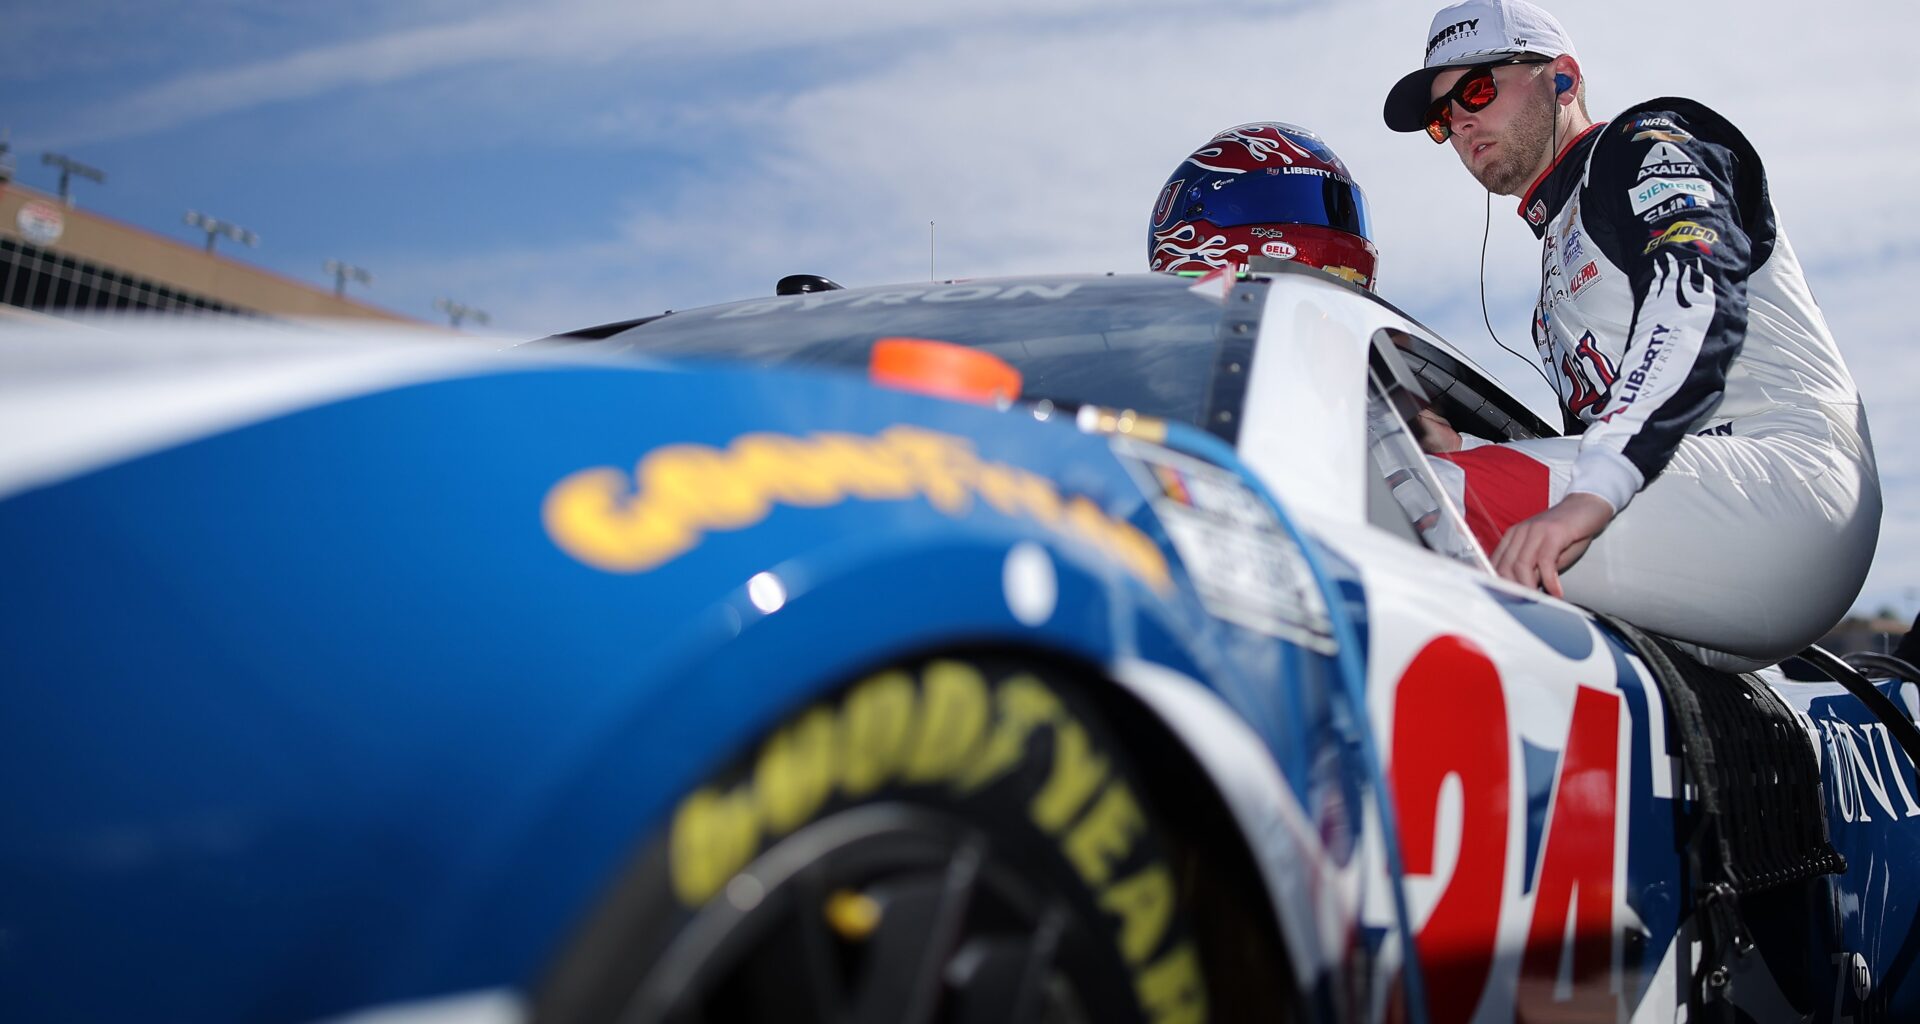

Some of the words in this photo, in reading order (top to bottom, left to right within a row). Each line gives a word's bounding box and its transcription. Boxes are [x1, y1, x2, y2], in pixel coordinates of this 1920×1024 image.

[1283, 166, 1331, 178] LIBERTY
[1637, 164, 1699, 181] AXALTA
[1638, 182, 1706, 203] SIEMENS
[1266, 244, 1291, 255] BELL
[1620, 323, 1670, 404] LIBERTY
[1640, 326, 1682, 398] NIVERSITY
